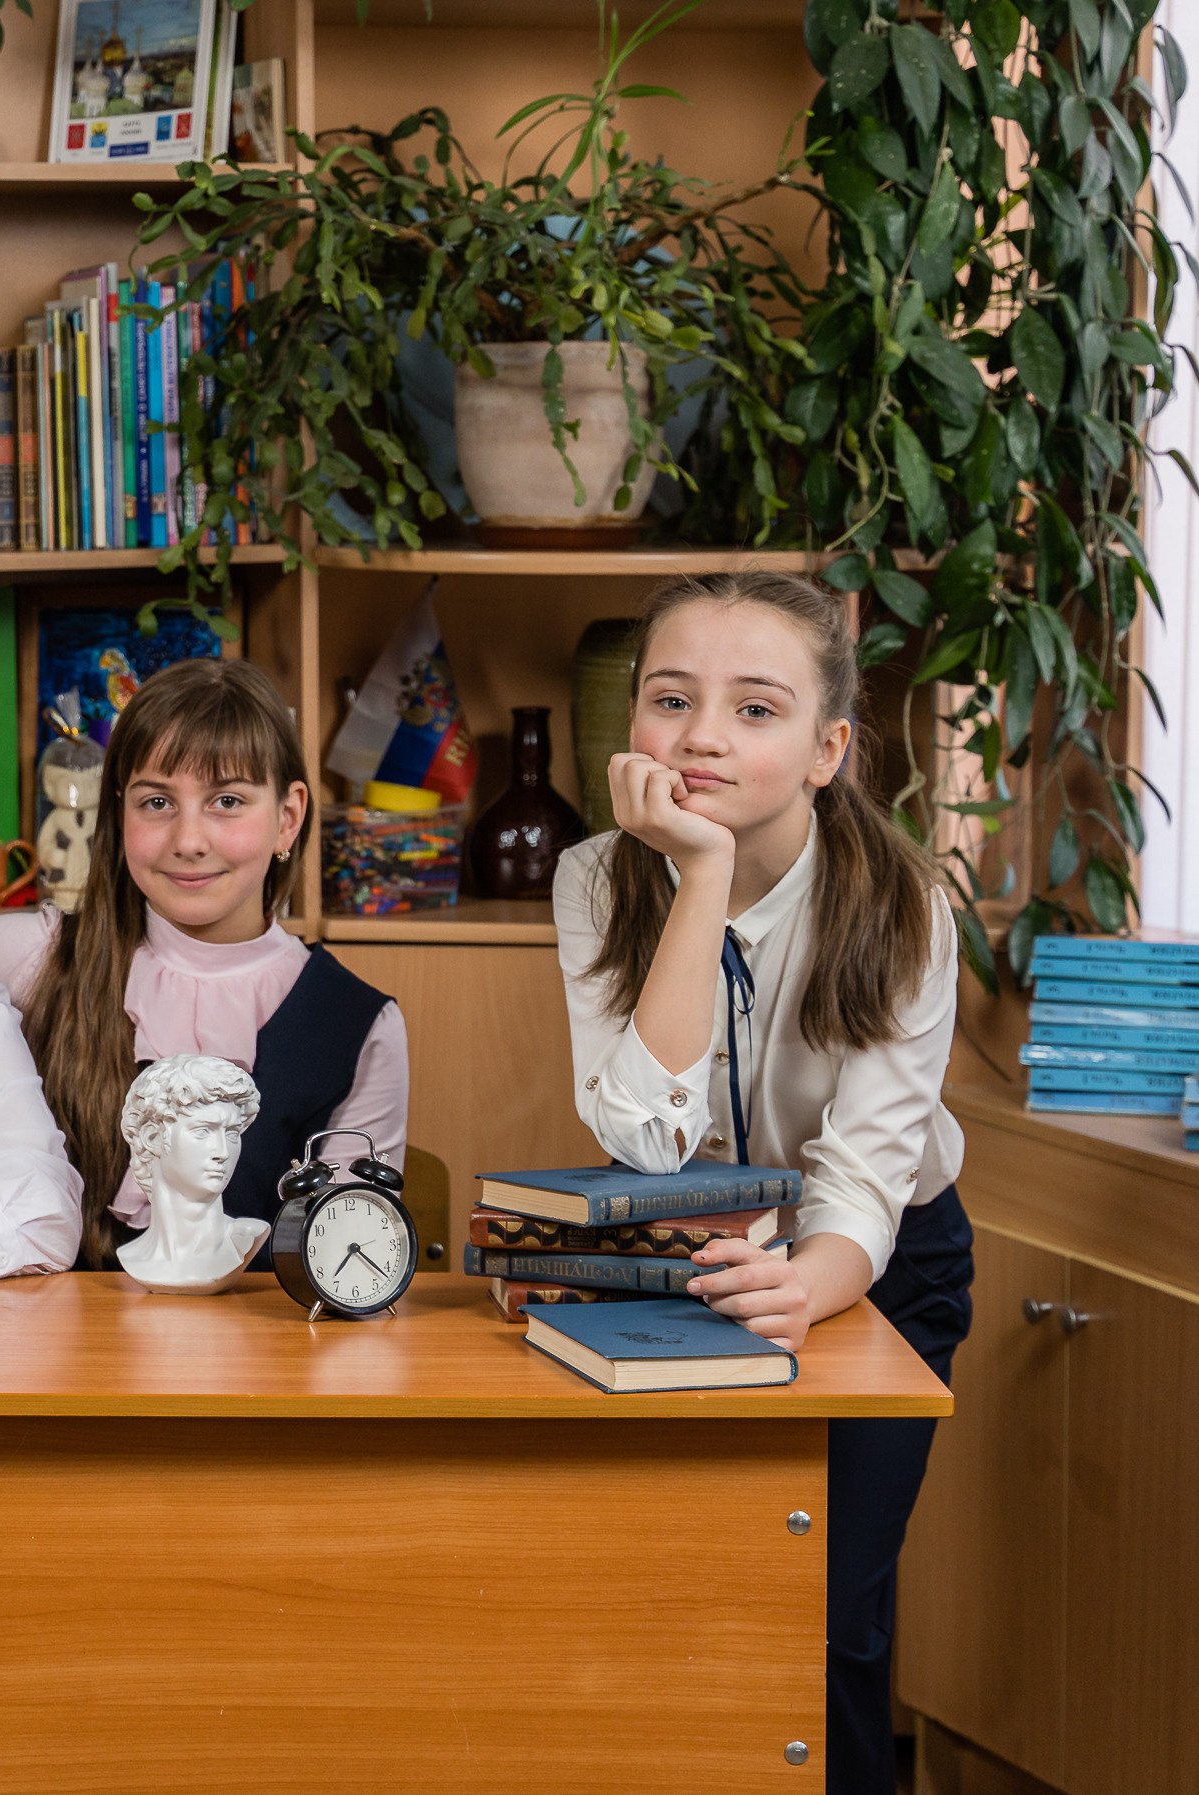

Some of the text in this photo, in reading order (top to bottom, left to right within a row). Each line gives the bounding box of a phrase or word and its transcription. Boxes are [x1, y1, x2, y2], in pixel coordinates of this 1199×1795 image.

[344, 1198, 356, 1211] 12
[367, 1203, 372, 1216] 1
[327, 1207, 337, 1220] 11
[381, 1217, 389, 1230] 2
[314, 1224, 325, 1237] 10
[309, 1245, 316, 1258] 9
[389, 1239, 397, 1252] 3
[316, 1266, 325, 1279] 8
[383, 1260, 391, 1272] 4
[333, 1280, 340, 1293] 7
[372, 1278, 379, 1291] 5
[352, 1285, 360, 1298] 6
